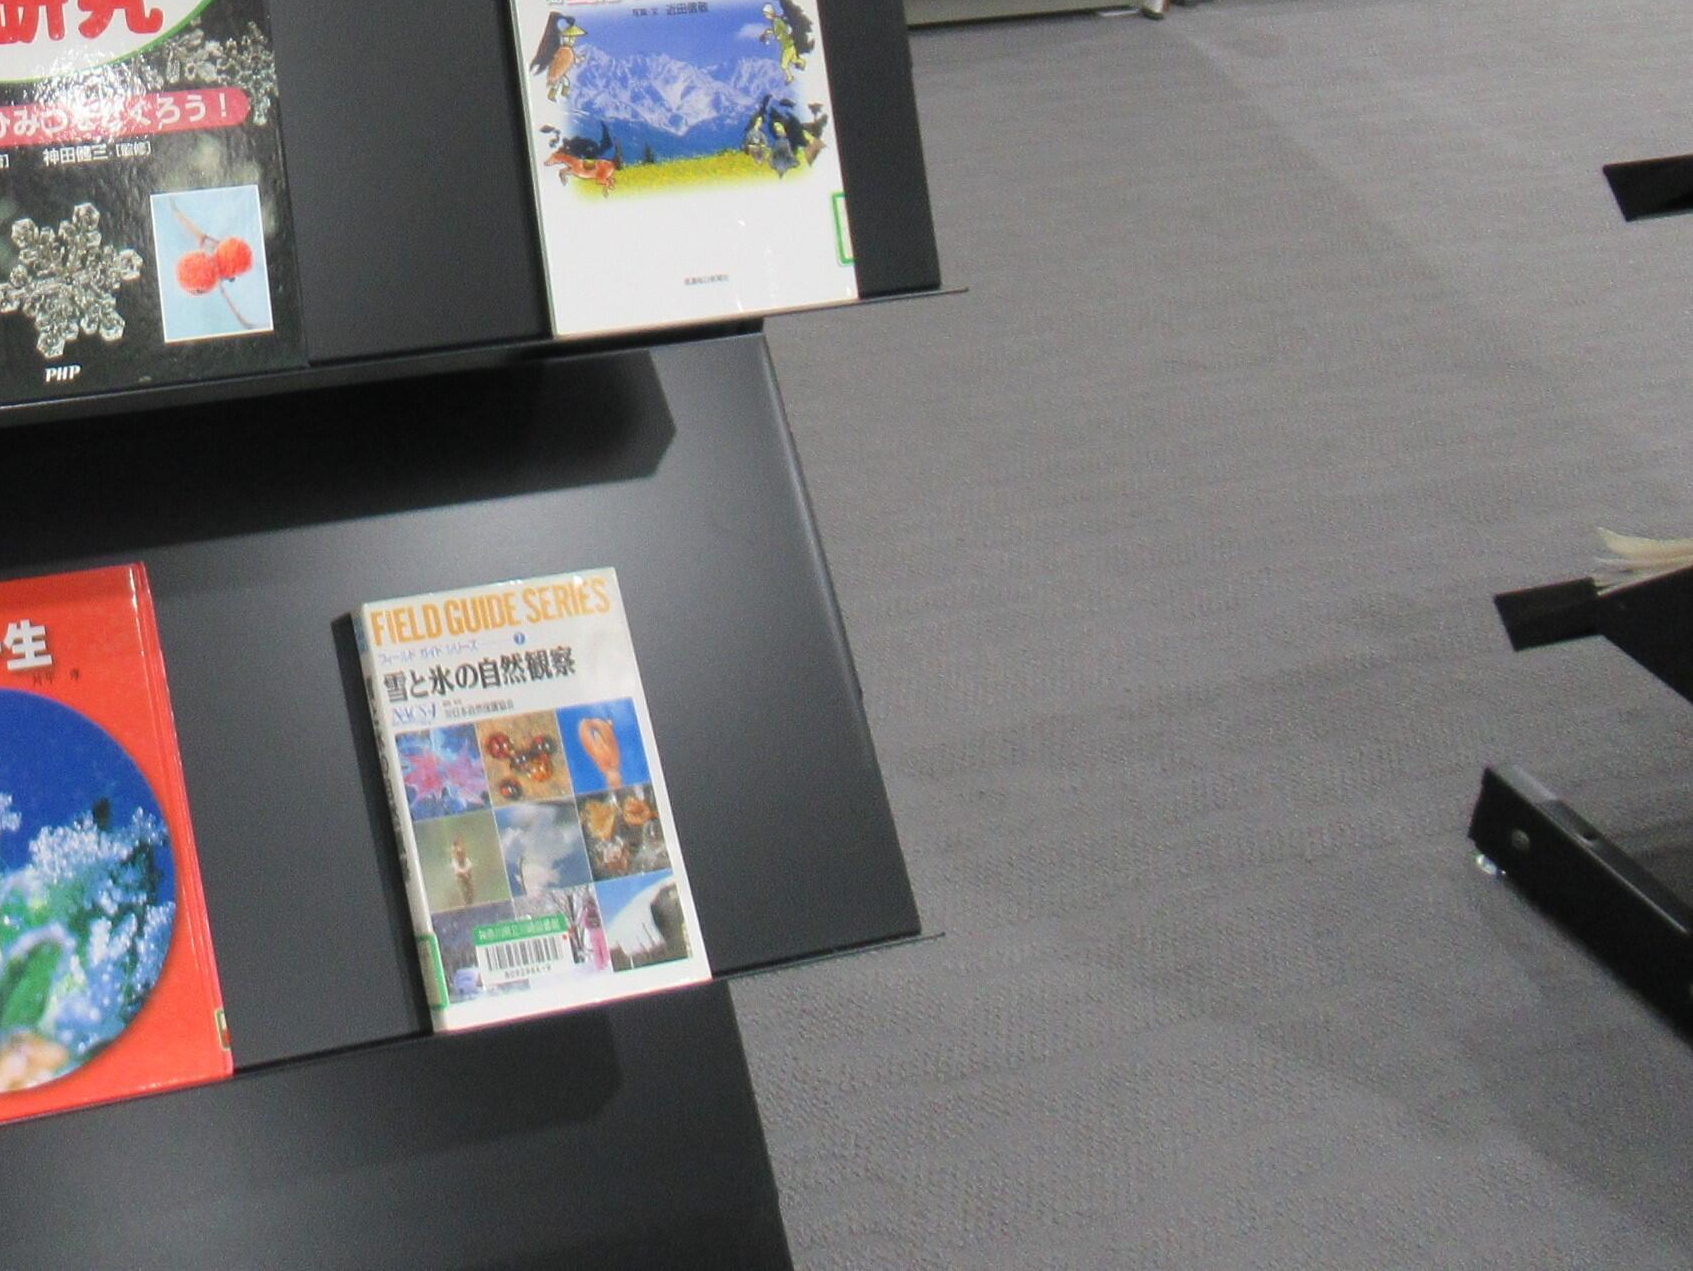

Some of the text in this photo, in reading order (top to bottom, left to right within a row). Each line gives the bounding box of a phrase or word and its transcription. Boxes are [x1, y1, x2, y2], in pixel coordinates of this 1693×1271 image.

[44, 365, 81, 382] PHP
[370, 580, 611, 647] FIELD GUIDE SERIES
[383, 645, 577, 703] 雪と氷の自然観察
